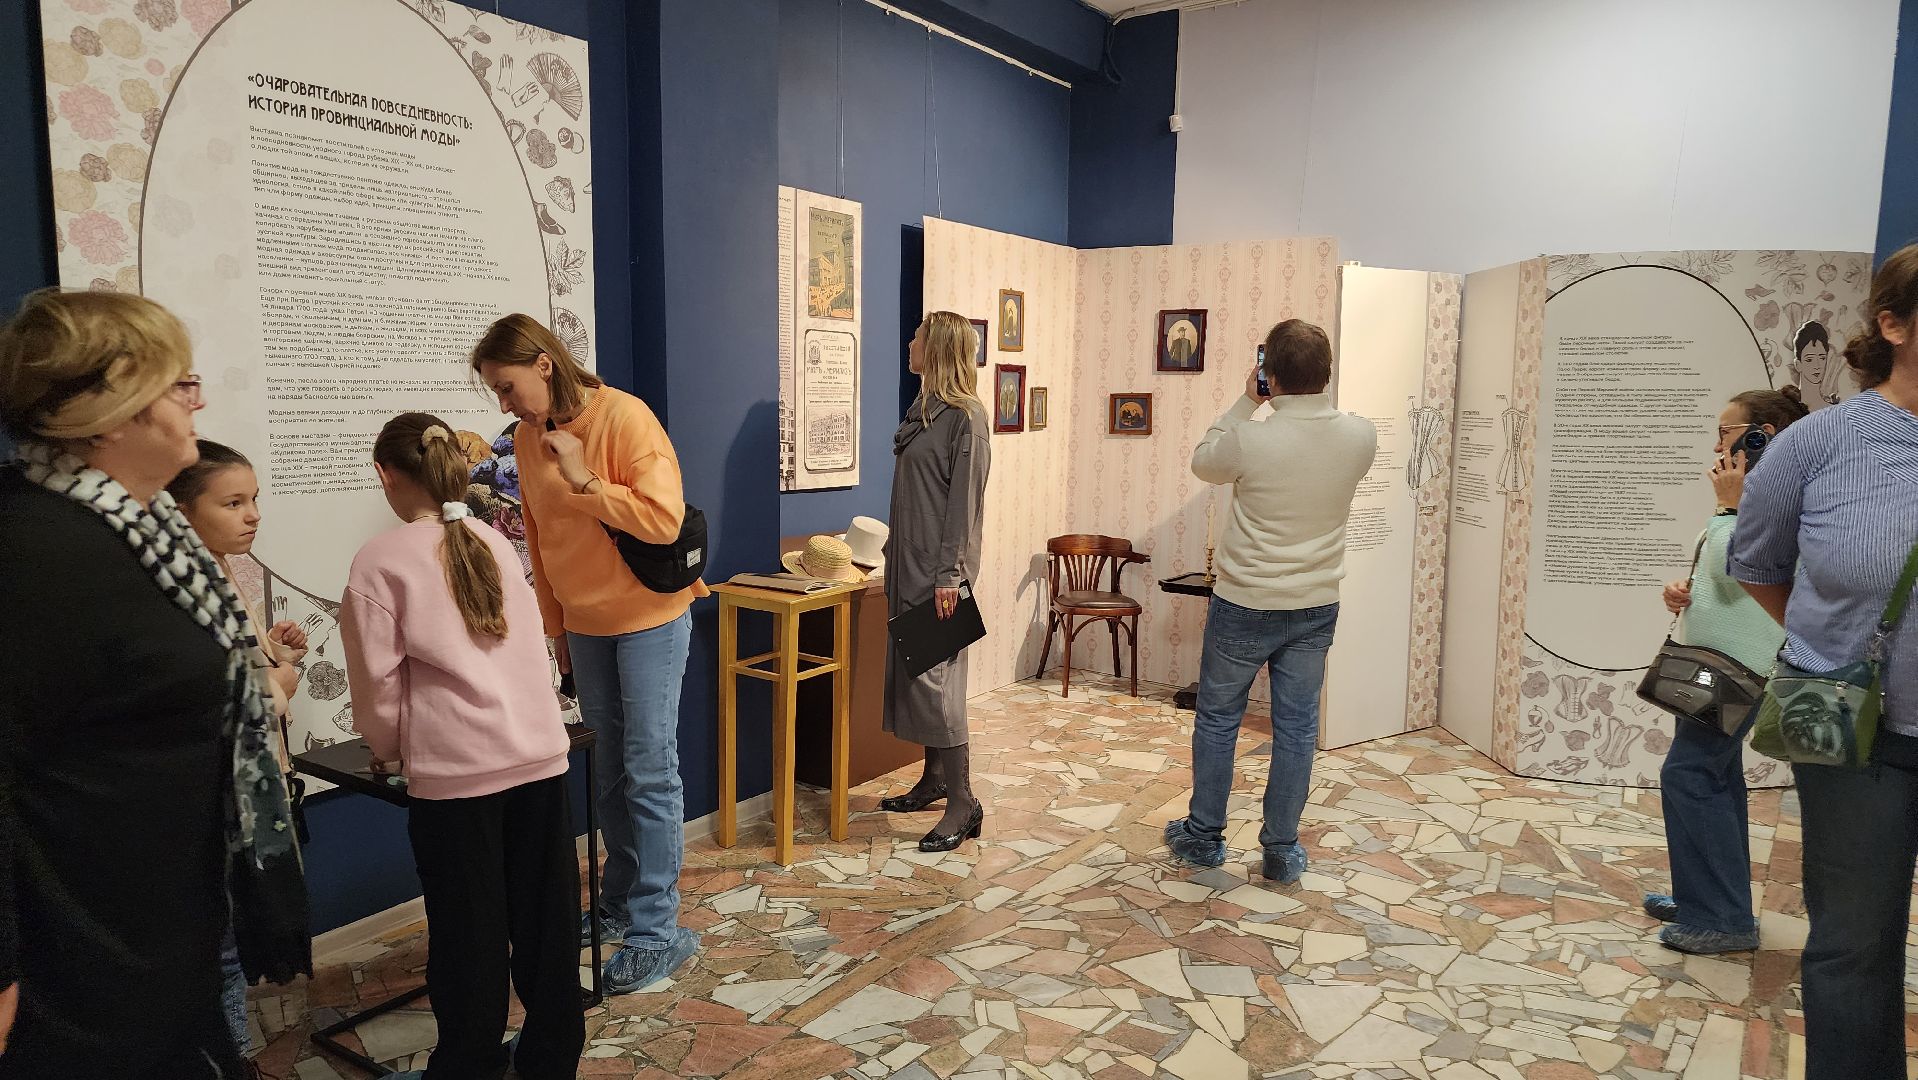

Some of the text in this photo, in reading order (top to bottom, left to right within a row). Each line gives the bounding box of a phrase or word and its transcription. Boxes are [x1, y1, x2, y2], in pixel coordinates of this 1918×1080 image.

[248, 73, 473, 130] «ОЧАРОВАТЕЛЬНАЯ ПОВСЕДНЕВНОСТЬ:
[248, 94, 461, 147] ИСТОРИЯ ПРОВИНЦИАЛЬНОЙ МОДЫ»
